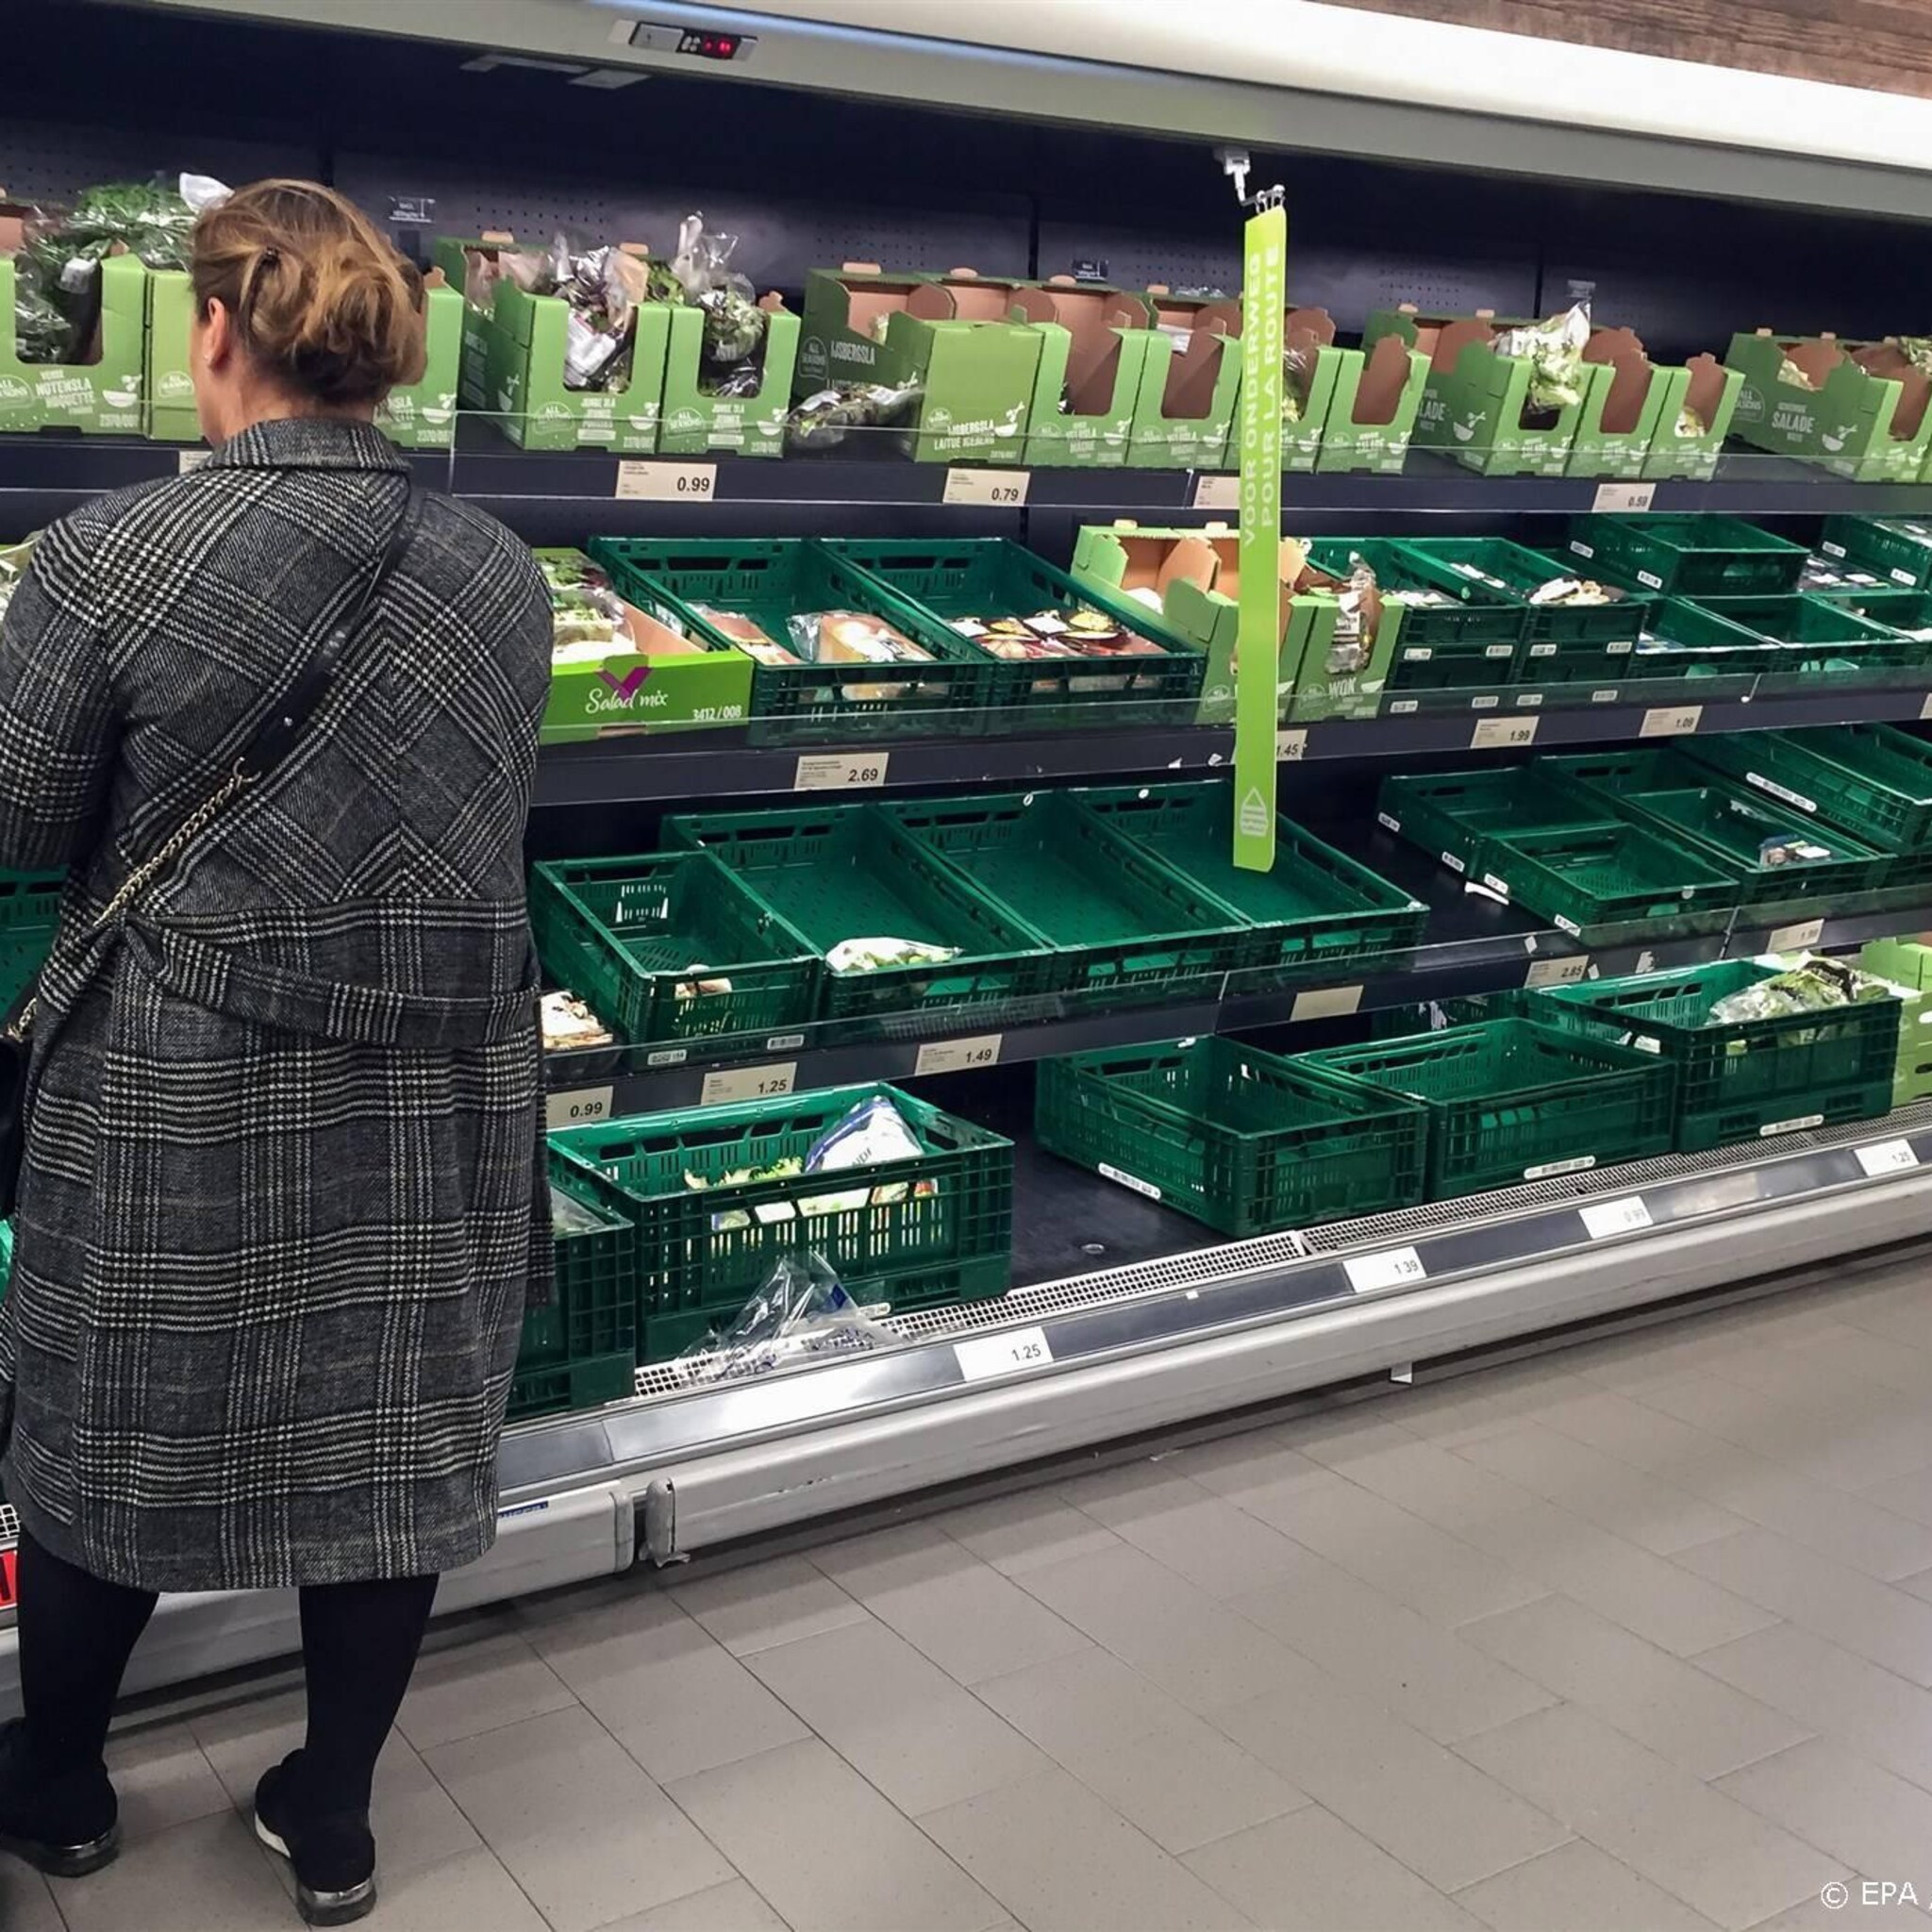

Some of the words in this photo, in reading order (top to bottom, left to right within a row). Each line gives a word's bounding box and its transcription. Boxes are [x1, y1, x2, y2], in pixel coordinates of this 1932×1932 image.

[1264, 243, 1280, 362] ROUTE
[1244, 252, 1261, 446] ONDERWEG
[1262, 380, 1276, 417] LA
[1772, 411, 1815, 433] SALADE
[676, 476, 711, 492] 0.99
[1260, 433, 1275, 527] POUR
[991, 487, 1020, 502] 0.79
[1242, 469, 1258, 547] VOOR
[1328, 677, 1357, 700] WOK
[585, 687, 638, 714] Salad
[639, 690, 669, 707] mix
[1509, 729, 1530, 742] 1.99
[848, 768, 879, 783] 2.69
[966, 1048, 993, 1063] 1.49
[758, 1078, 788, 1094] 1.25
[570, 1101, 603, 1118] 0.99
[1012, 1343, 1042, 1363] 1.25
